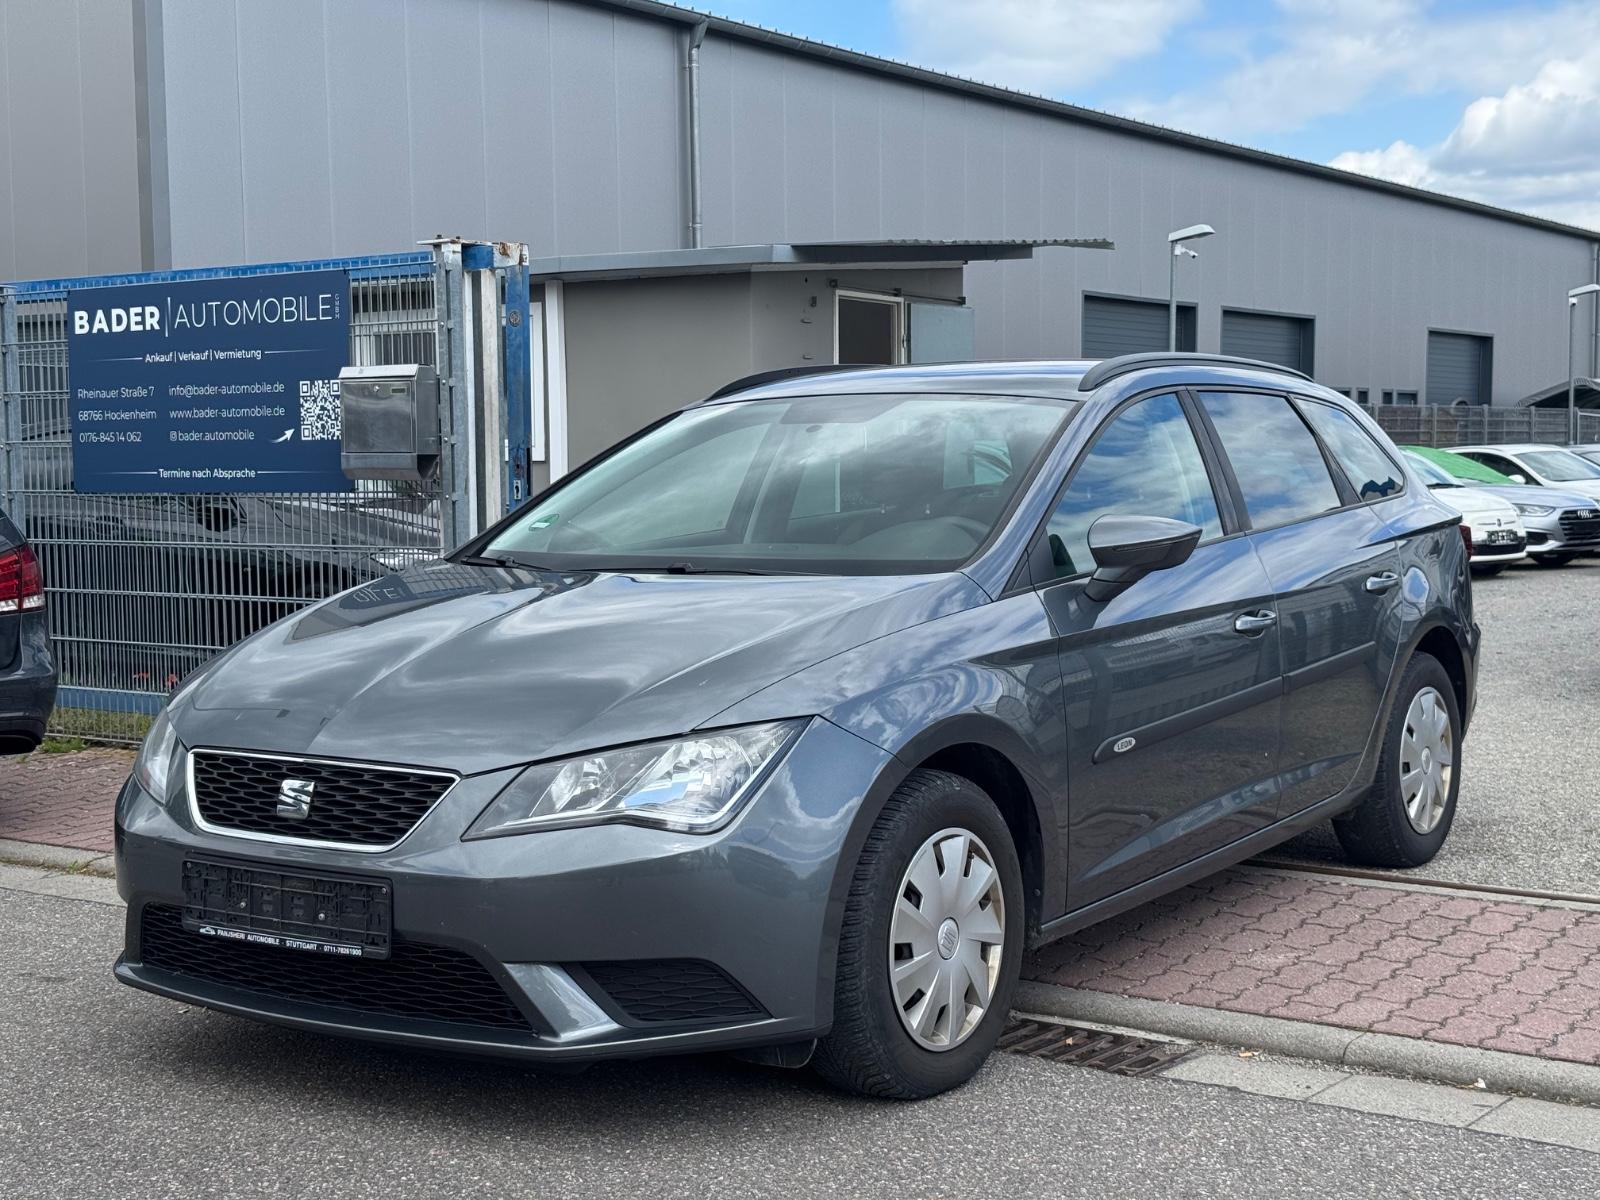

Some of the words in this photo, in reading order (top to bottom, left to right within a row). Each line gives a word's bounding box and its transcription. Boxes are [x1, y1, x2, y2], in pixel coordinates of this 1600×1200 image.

[74, 305, 160, 335] BADER
[174, 293, 332, 329] AUTOMOBILE
[145, 352, 173, 363] Ankauf
[178, 350, 209, 361] Verkauf
[214, 348, 262, 360] Vermietung
[77, 388, 118, 399] Rheinauer
[120, 386, 148, 398] Straße
[148, 386, 155, 397] 7
[168, 382, 285, 398] info@bader-automobile.de
[78, 410, 103, 421] 68766
[104, 408, 157, 420] Hockenheim
[169, 405, 286, 418] www.bader-automobile.de
[126, 431, 142, 442] 062
[158, 468, 190, 478] Termine
[192, 468, 211, 478] nach
[212, 468, 256, 480] Absprache
[1117, 738, 1133, 751] LEON
[247, 934, 280, 945] AUTOMOBILE
[285, 940, 317, 950] STUTTGART
